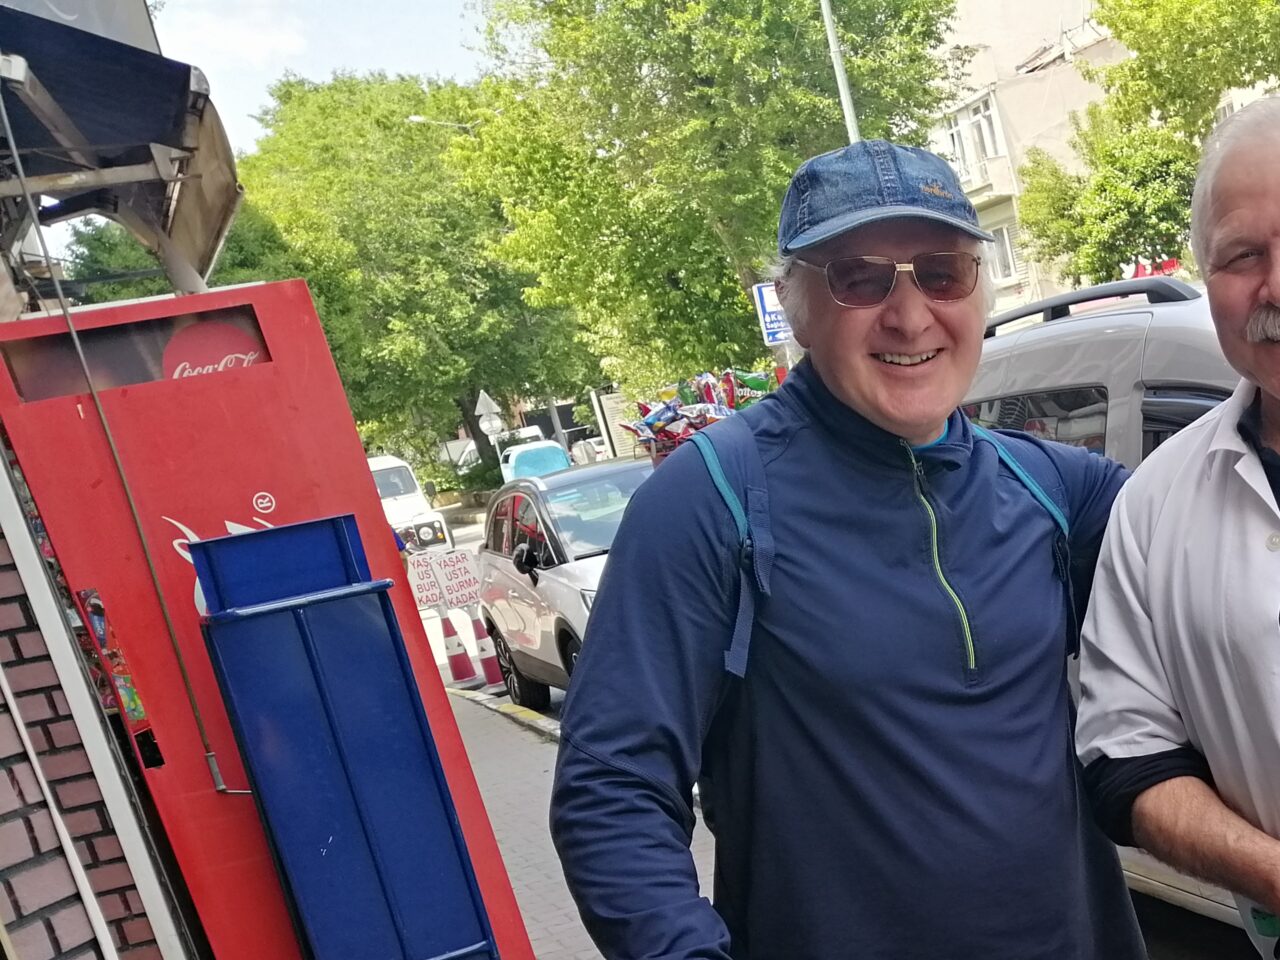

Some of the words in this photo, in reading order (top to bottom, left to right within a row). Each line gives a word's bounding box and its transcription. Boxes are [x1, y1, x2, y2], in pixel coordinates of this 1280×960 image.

[417, 569, 432, 581] US
[445, 566, 471, 581] USTA
[416, 581, 438, 594] BUR
[445, 576, 480, 595] BURMA
[448, 589, 480, 608] KADAY
